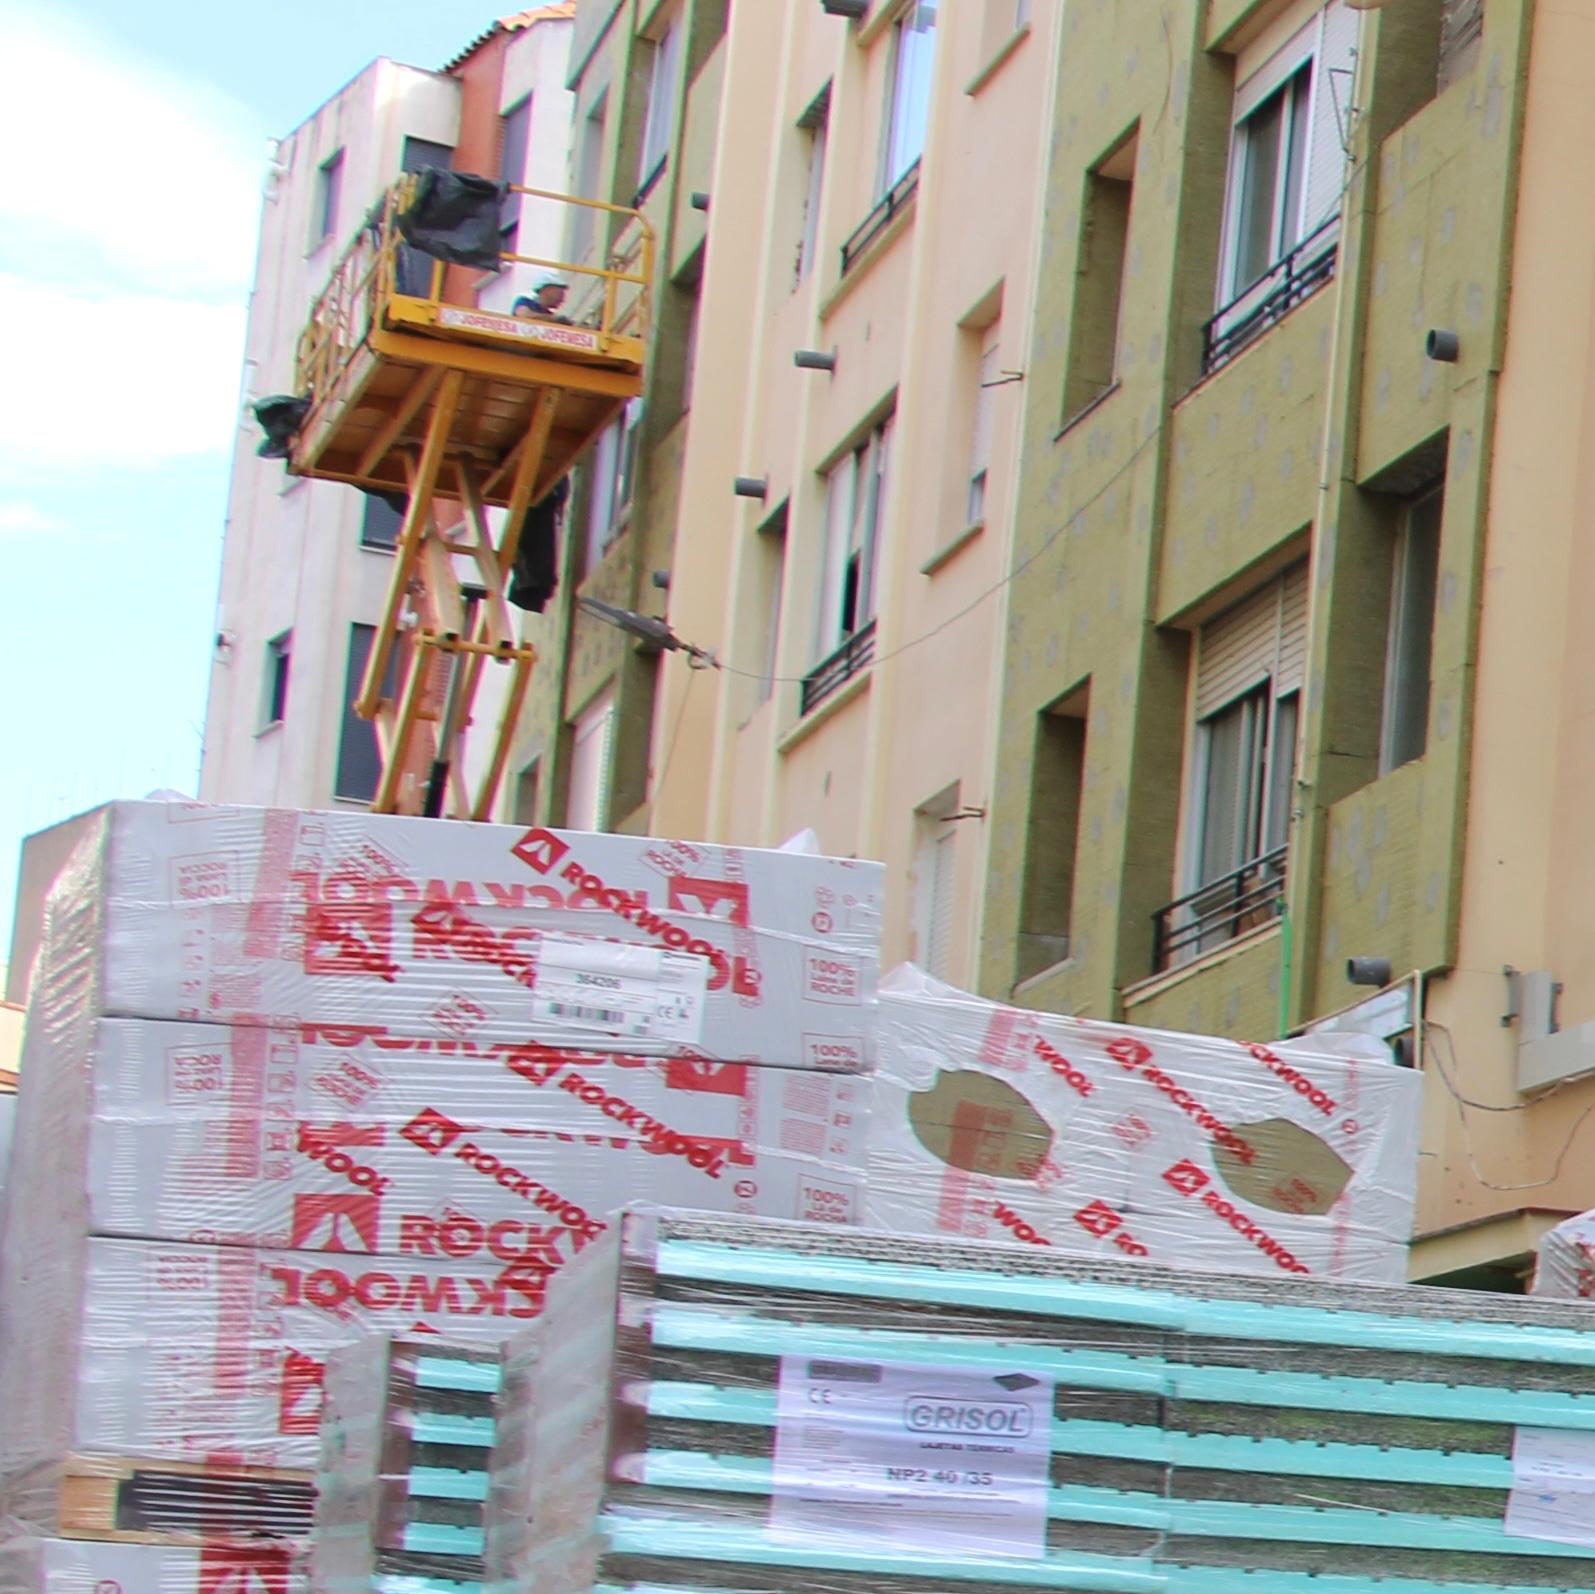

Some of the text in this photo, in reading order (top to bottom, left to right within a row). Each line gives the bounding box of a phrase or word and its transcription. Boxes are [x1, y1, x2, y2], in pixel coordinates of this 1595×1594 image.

[560, 861, 727, 962] ROCKWOOL
[809, 958, 857, 977] 100%
[809, 1043, 858, 1060] 100%
[558, 1072, 724, 1180] ROCKWOOL
[1142, 1064, 1258, 1166] ROCKWOOL
[910, 1403, 1027, 1433] GRISOL
[886, 1466, 928, 1482] NP2
